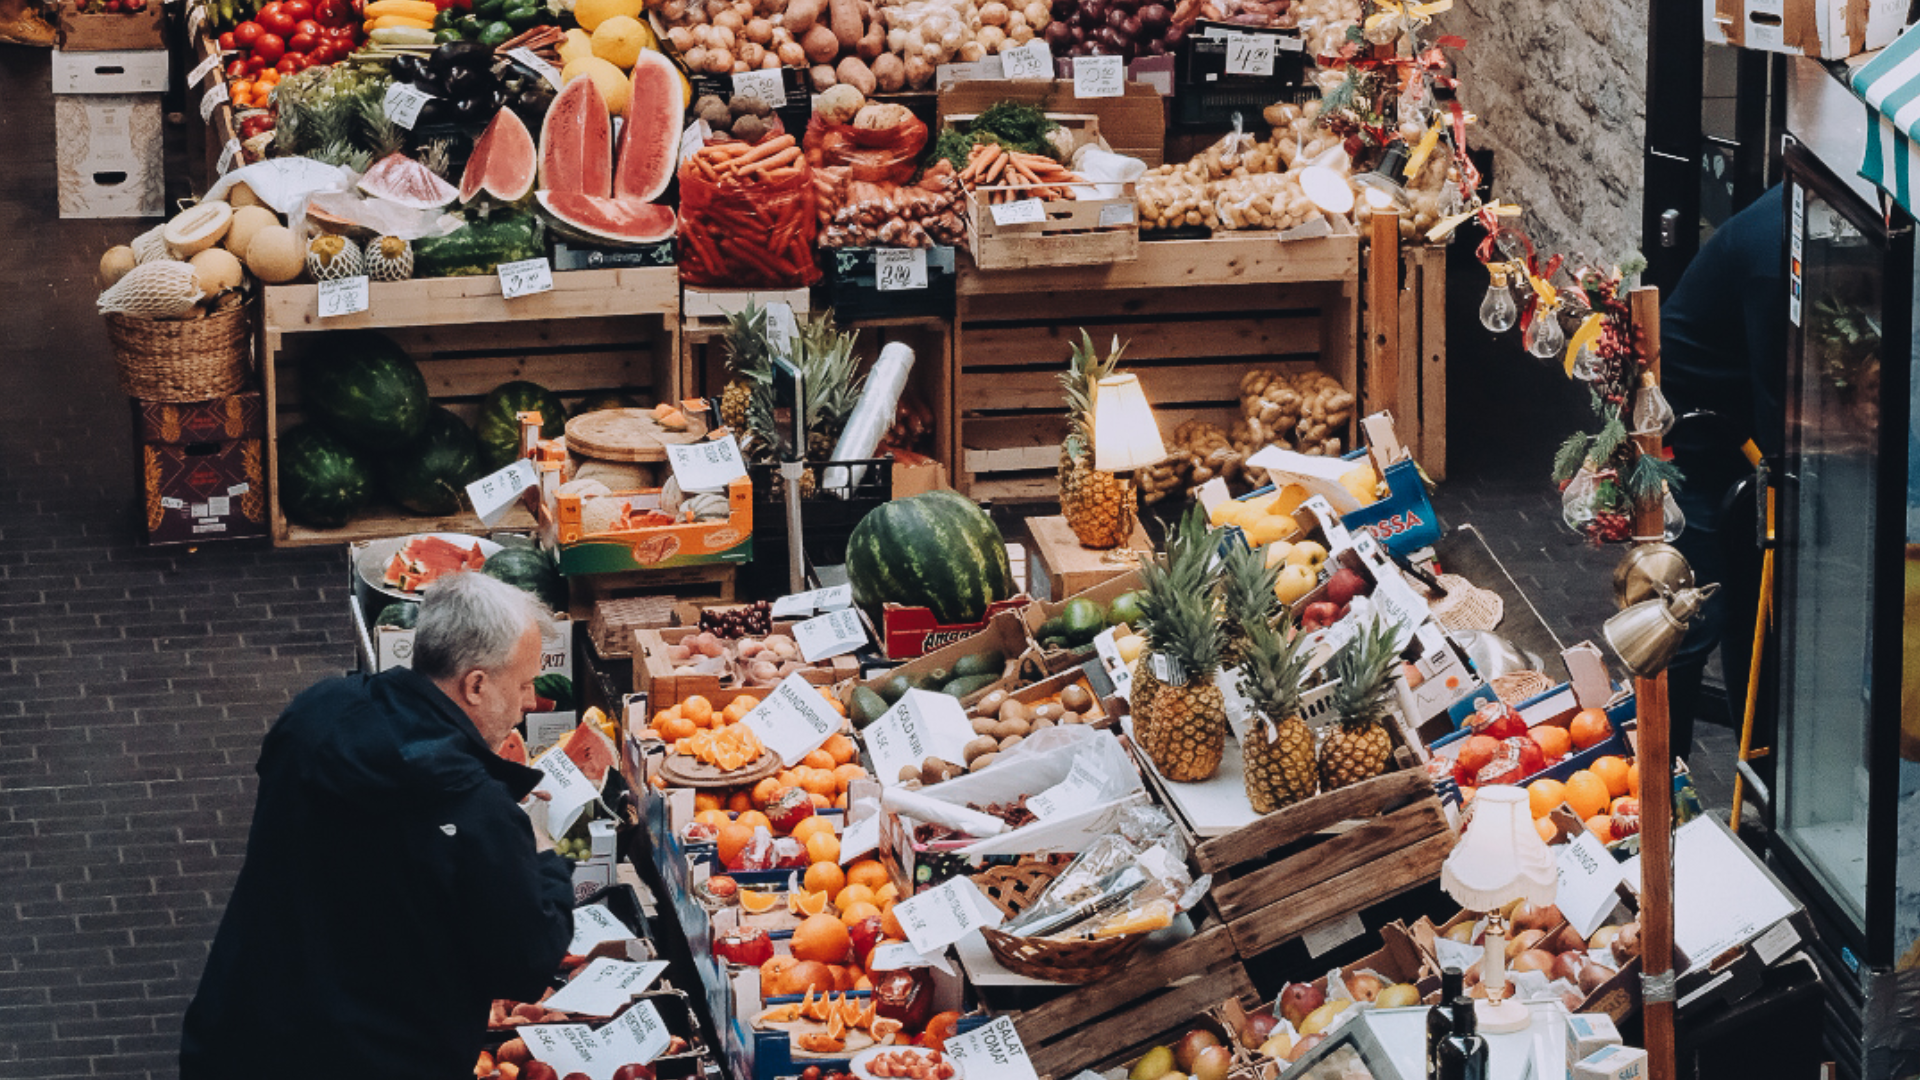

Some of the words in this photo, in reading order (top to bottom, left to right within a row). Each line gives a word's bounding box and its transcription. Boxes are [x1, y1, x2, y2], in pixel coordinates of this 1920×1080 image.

[779, 684, 829, 735] MANDARIINID
[896, 703, 915, 734] GOLD
[1570, 842, 1599, 875] MANGO
[980, 1025, 1009, 1065] TOMAT
[994, 1019, 1023, 1056] SALAT
